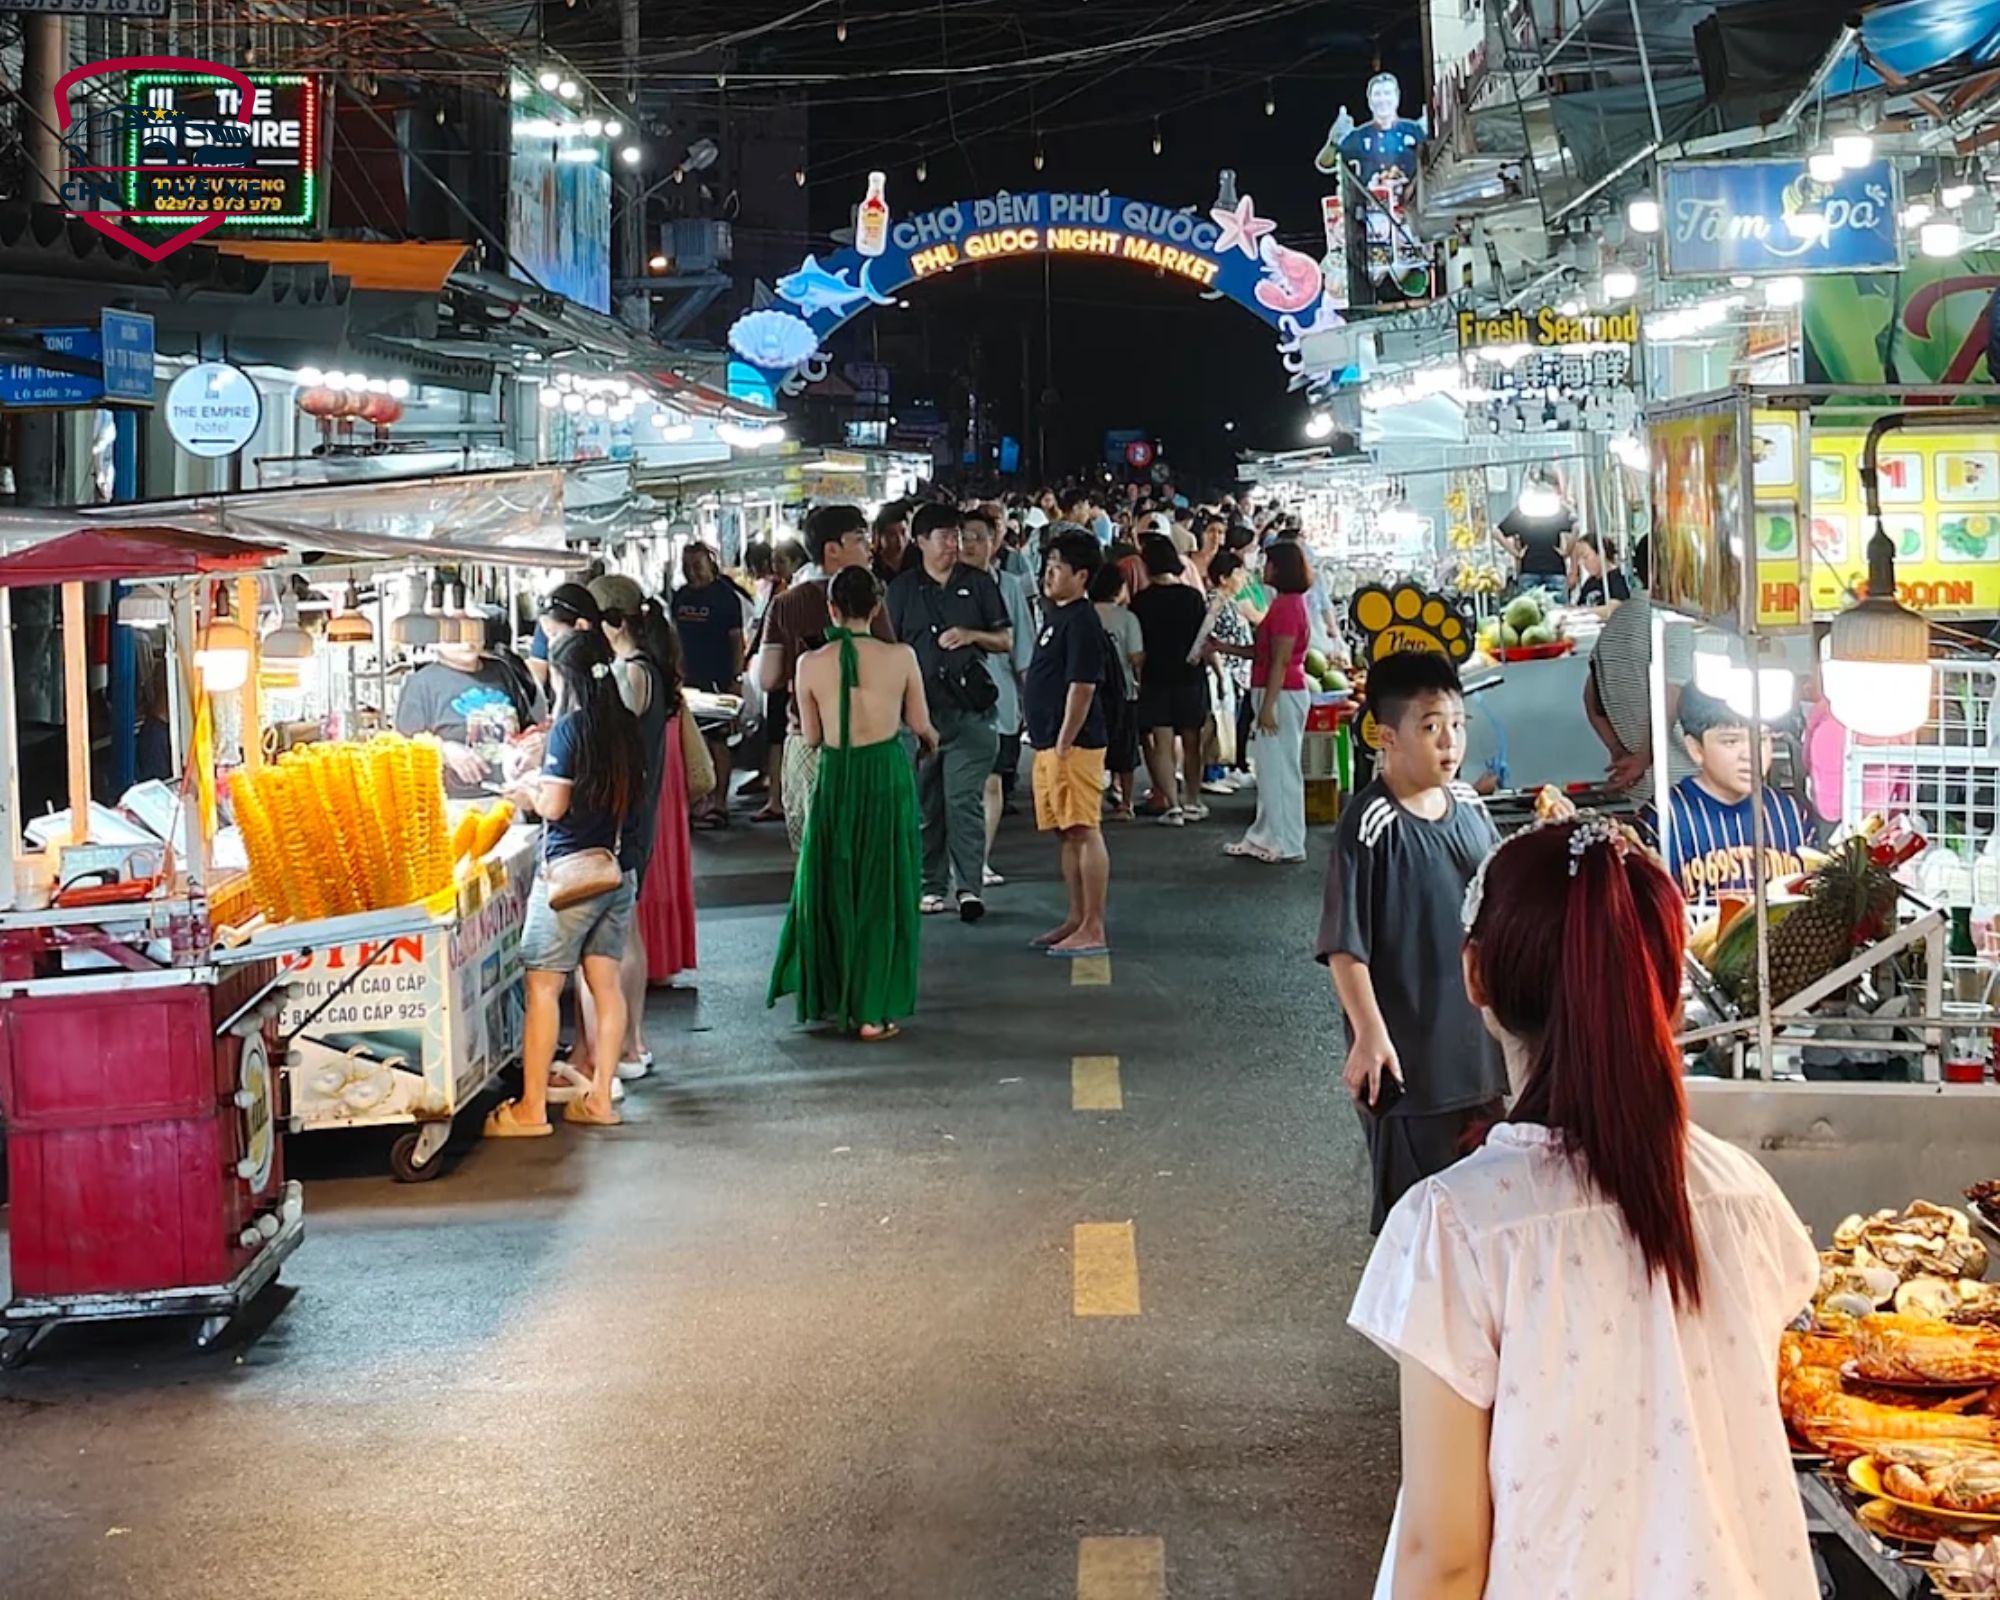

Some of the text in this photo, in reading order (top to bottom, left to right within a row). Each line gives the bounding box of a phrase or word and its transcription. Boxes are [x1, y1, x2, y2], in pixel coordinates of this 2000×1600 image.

[214, 88, 272, 115] THE
[893, 201, 964, 250] CHỢ
[974, 190, 1040, 227] ĐÊM
[1050, 189, 1111, 223] PHÚ
[1121, 204, 1217, 250] QUỐC
[1676, 198, 1771, 242] Tâm
[1047, 228, 1122, 255] NIGHT
[1123, 236, 1219, 284] MARKET
[1459, 310, 1529, 347] Fresh
[174, 406, 251, 418] THE EMPIRE
[1683, 845, 1801, 897] 1969STDIO
[361, 977, 391, 994] CAO
[327, 1007, 358, 1023] CAO
[398, 1004, 427, 1019] 925
